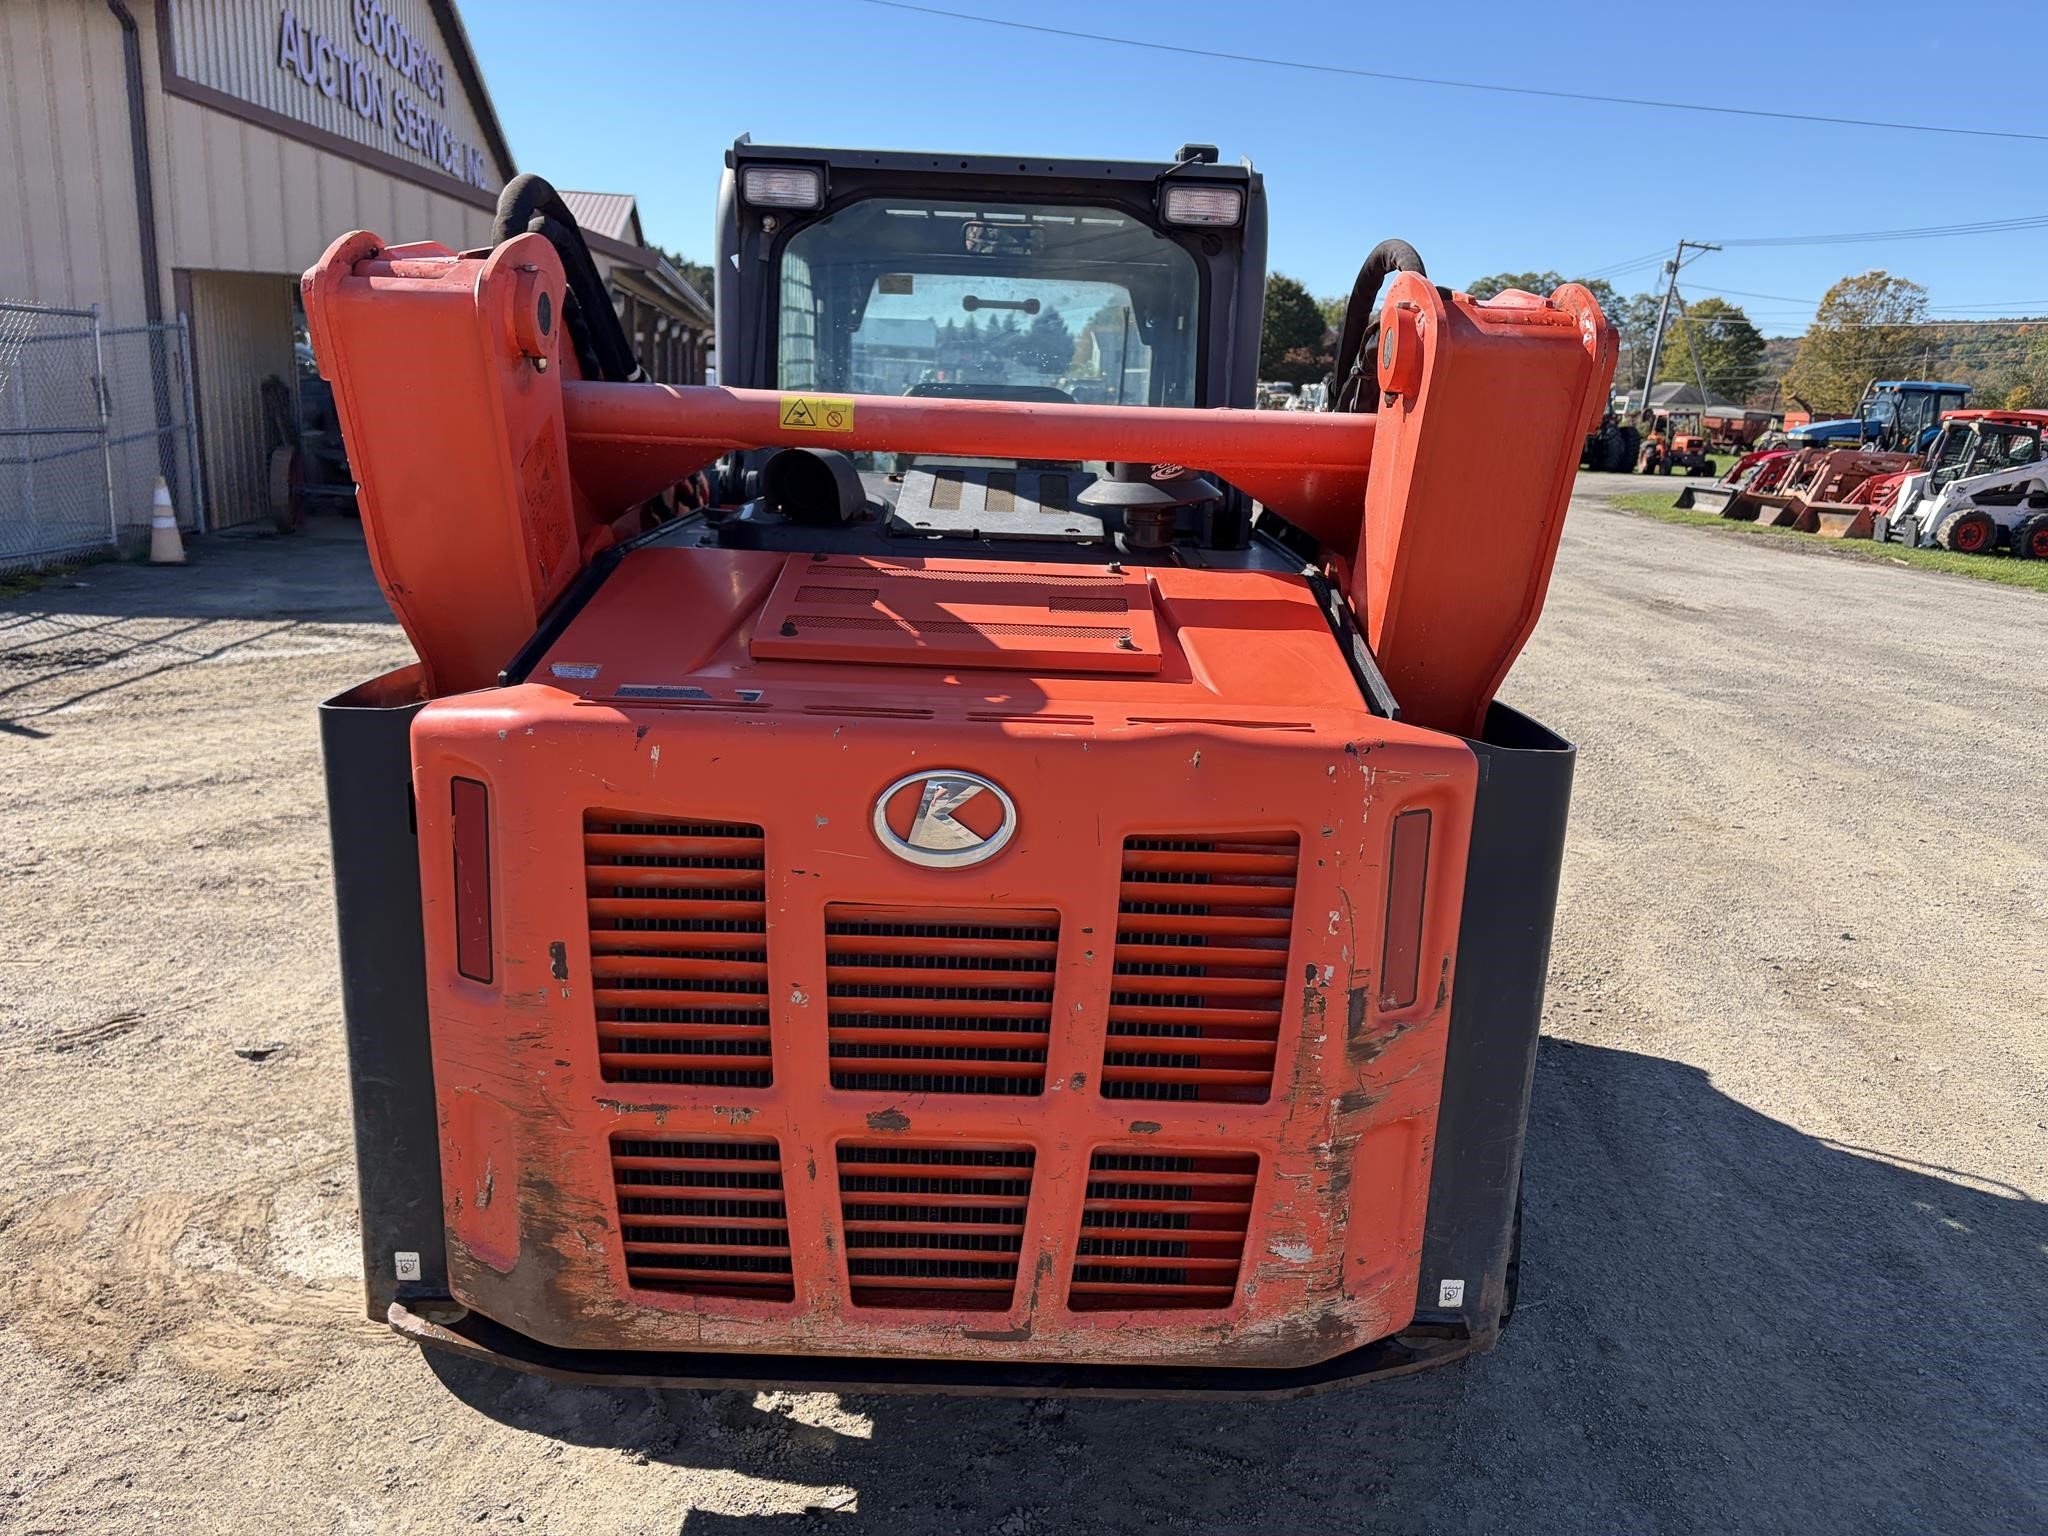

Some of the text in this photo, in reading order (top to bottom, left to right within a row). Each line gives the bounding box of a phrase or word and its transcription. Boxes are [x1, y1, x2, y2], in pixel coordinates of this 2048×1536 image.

[279, 9, 387, 129] AUCTION
[394, 88, 465, 181] SERVICE
[353, 0, 447, 108] GOODRICH
